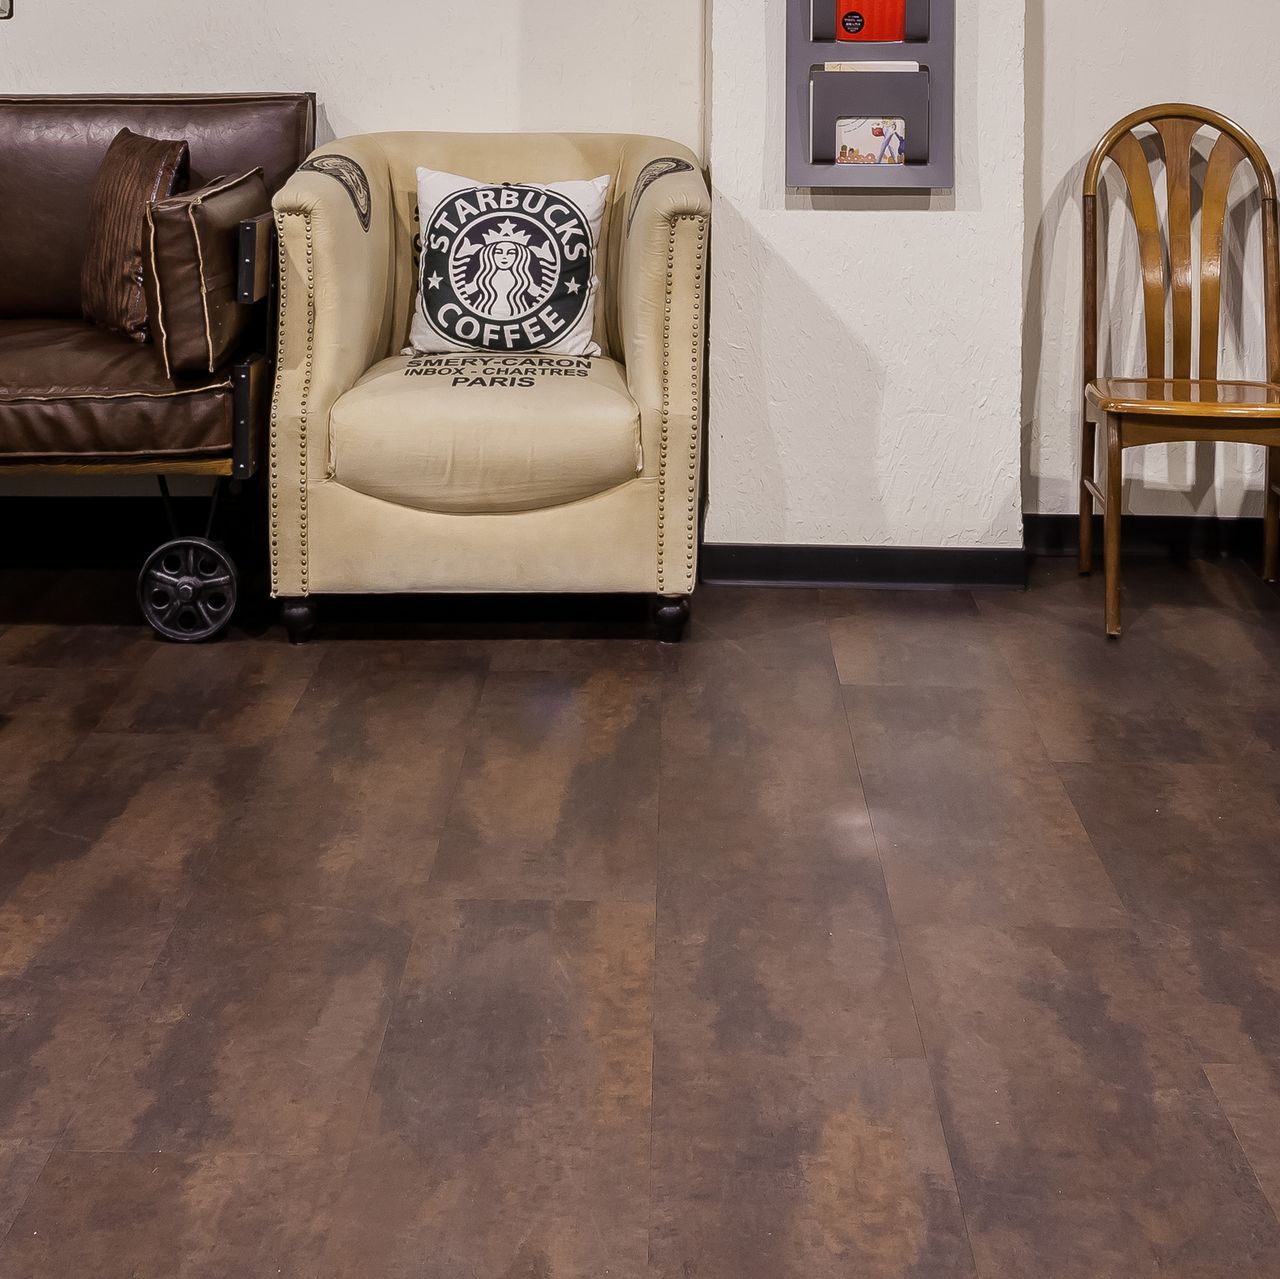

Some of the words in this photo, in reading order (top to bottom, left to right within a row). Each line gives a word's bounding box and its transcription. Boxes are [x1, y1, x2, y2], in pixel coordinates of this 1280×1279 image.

[430, 189, 588, 261] STARBUCKS
[437, 305, 566, 348] COFFEE
[404, 368, 466, 376] INBOX
[482, 368, 589, 377] CHARTRES
[452, 377, 536, 388] PARIS
